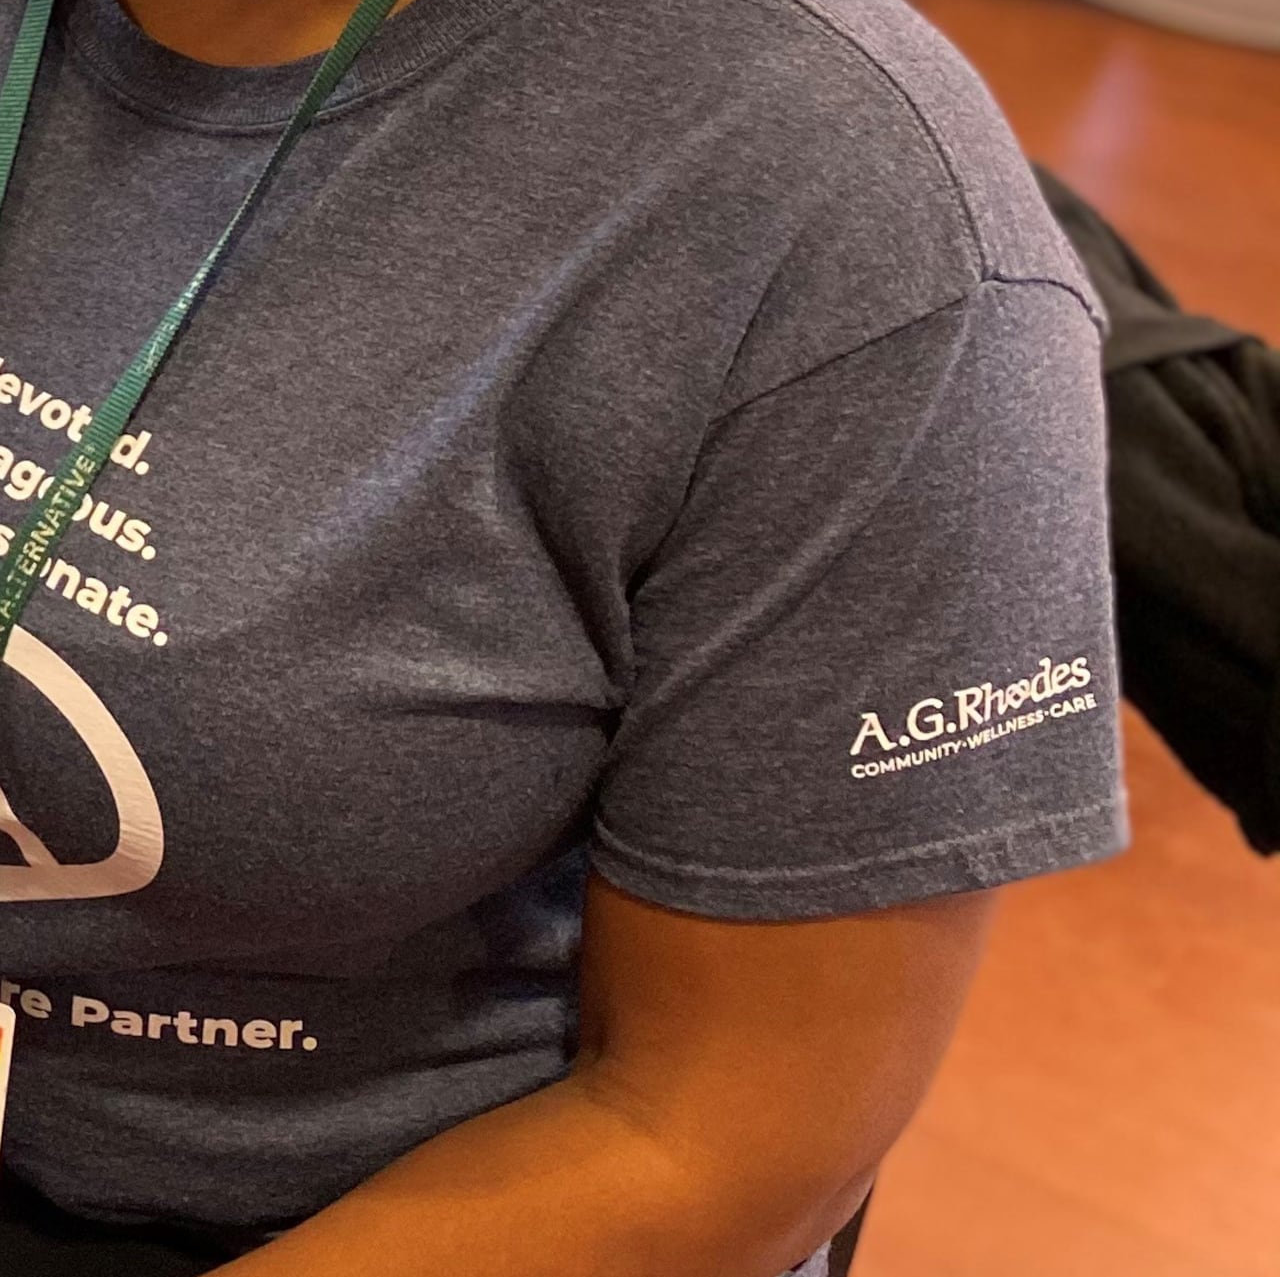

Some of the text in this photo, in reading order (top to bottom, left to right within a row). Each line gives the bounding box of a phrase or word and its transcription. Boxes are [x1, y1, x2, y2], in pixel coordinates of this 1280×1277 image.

[850, 692, 1098, 780] COMMUNITY WELLNESS CARE
[70, 995, 319, 1052] Partner.
